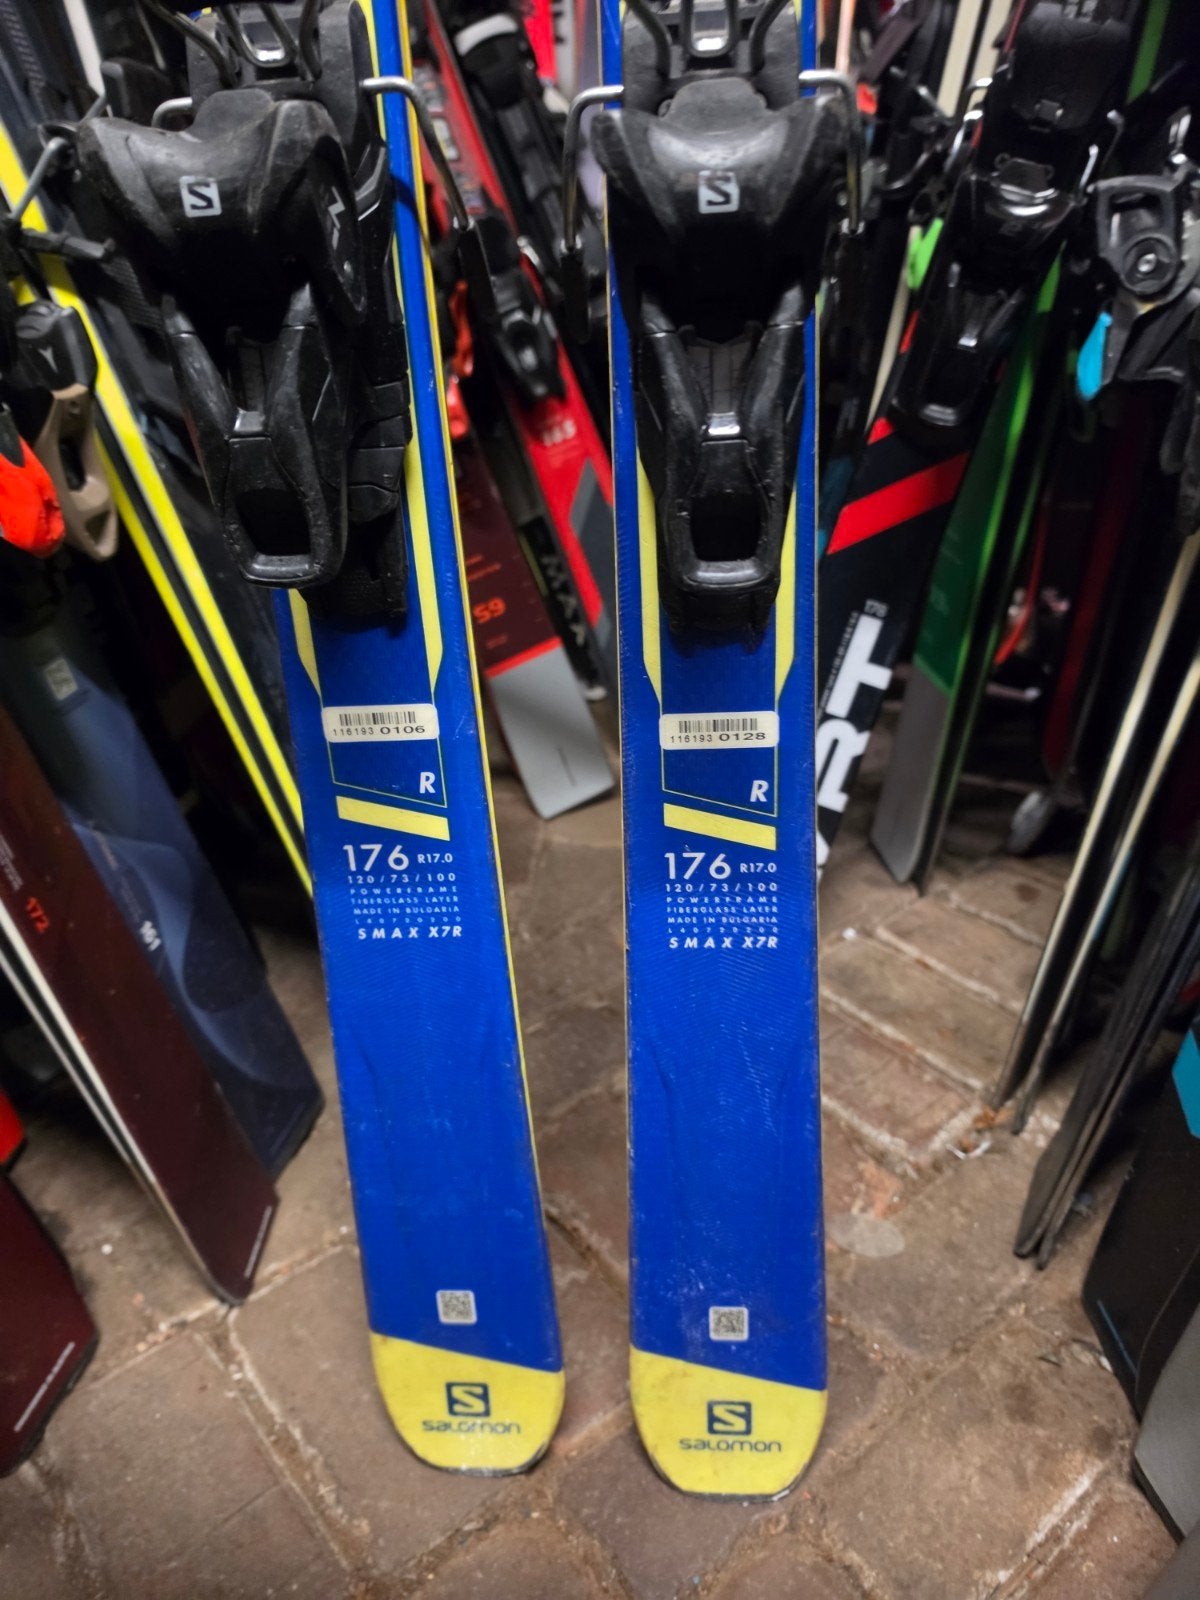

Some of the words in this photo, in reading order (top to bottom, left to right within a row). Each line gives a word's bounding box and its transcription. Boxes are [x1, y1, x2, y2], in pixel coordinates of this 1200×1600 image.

[333, 726, 374, 737] 116193
[380, 725, 425, 735] 0106
[670, 734, 713, 743] 116193
[719, 732, 766, 742] 0128
[816, 614, 893, 868] RT
[419, 771, 436, 794] R
[750, 780, 769, 802] R
[342, 844, 410, 872] 176
[417, 852, 453, 864] R17.0
[664, 852, 731, 880] 176
[740, 862, 777, 873] R17.0
[428, 925, 462, 938] X7R
[742, 936, 778, 949] X7R
[422, 1419, 521, 1434] salomon
[679, 1438, 782, 1452] salomon
